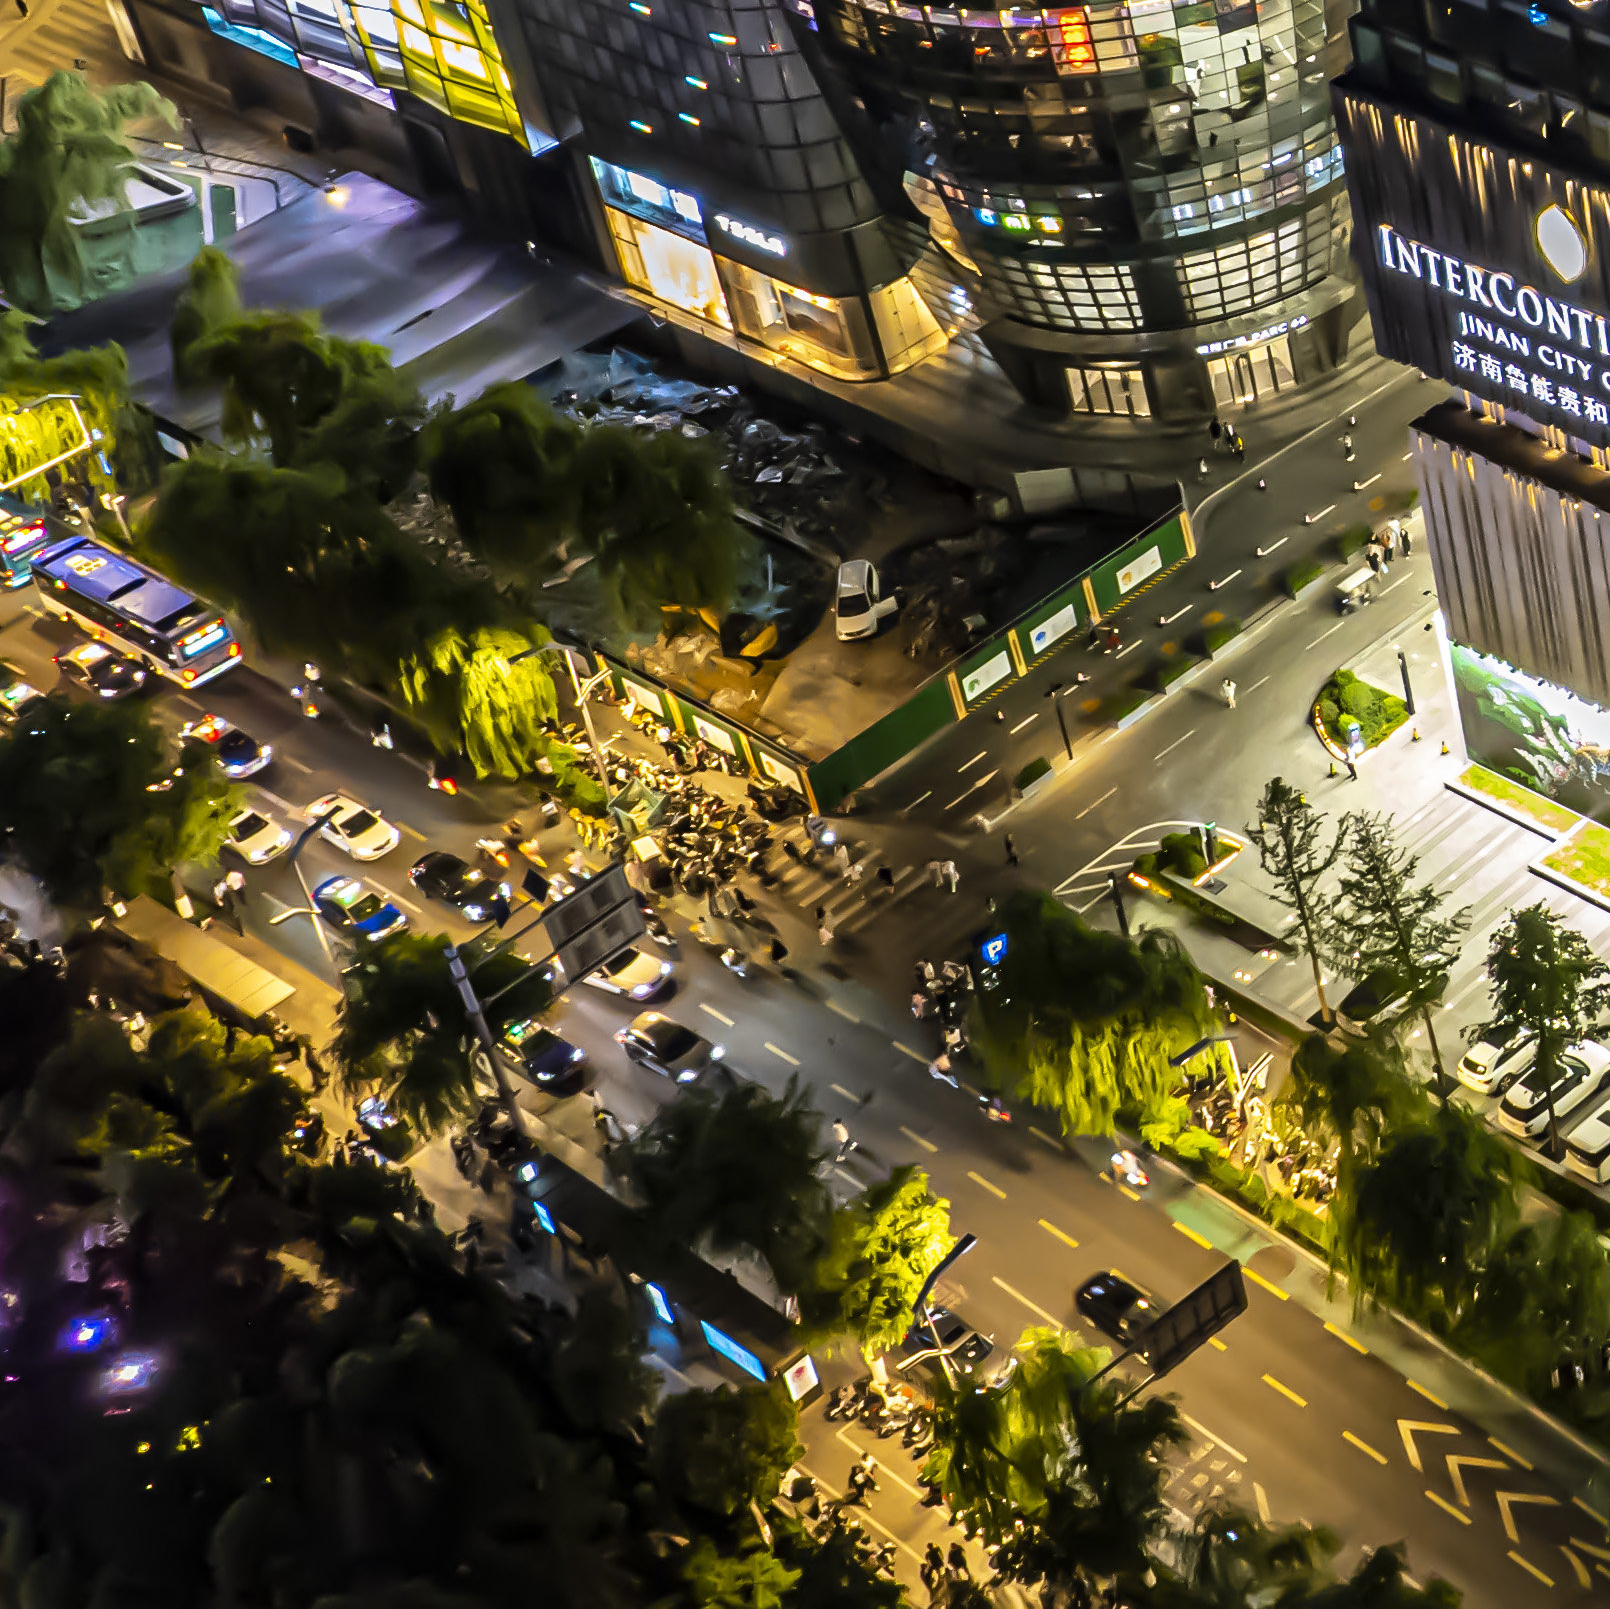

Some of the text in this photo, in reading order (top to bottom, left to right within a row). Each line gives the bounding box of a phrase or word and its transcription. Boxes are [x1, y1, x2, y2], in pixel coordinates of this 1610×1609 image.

[1251, 322, 1288, 341] PARC
[1459, 312, 1530, 357] JINAN
[1539, 345, 1592, 381] CITY
[987, 940, 1003, 960] P
